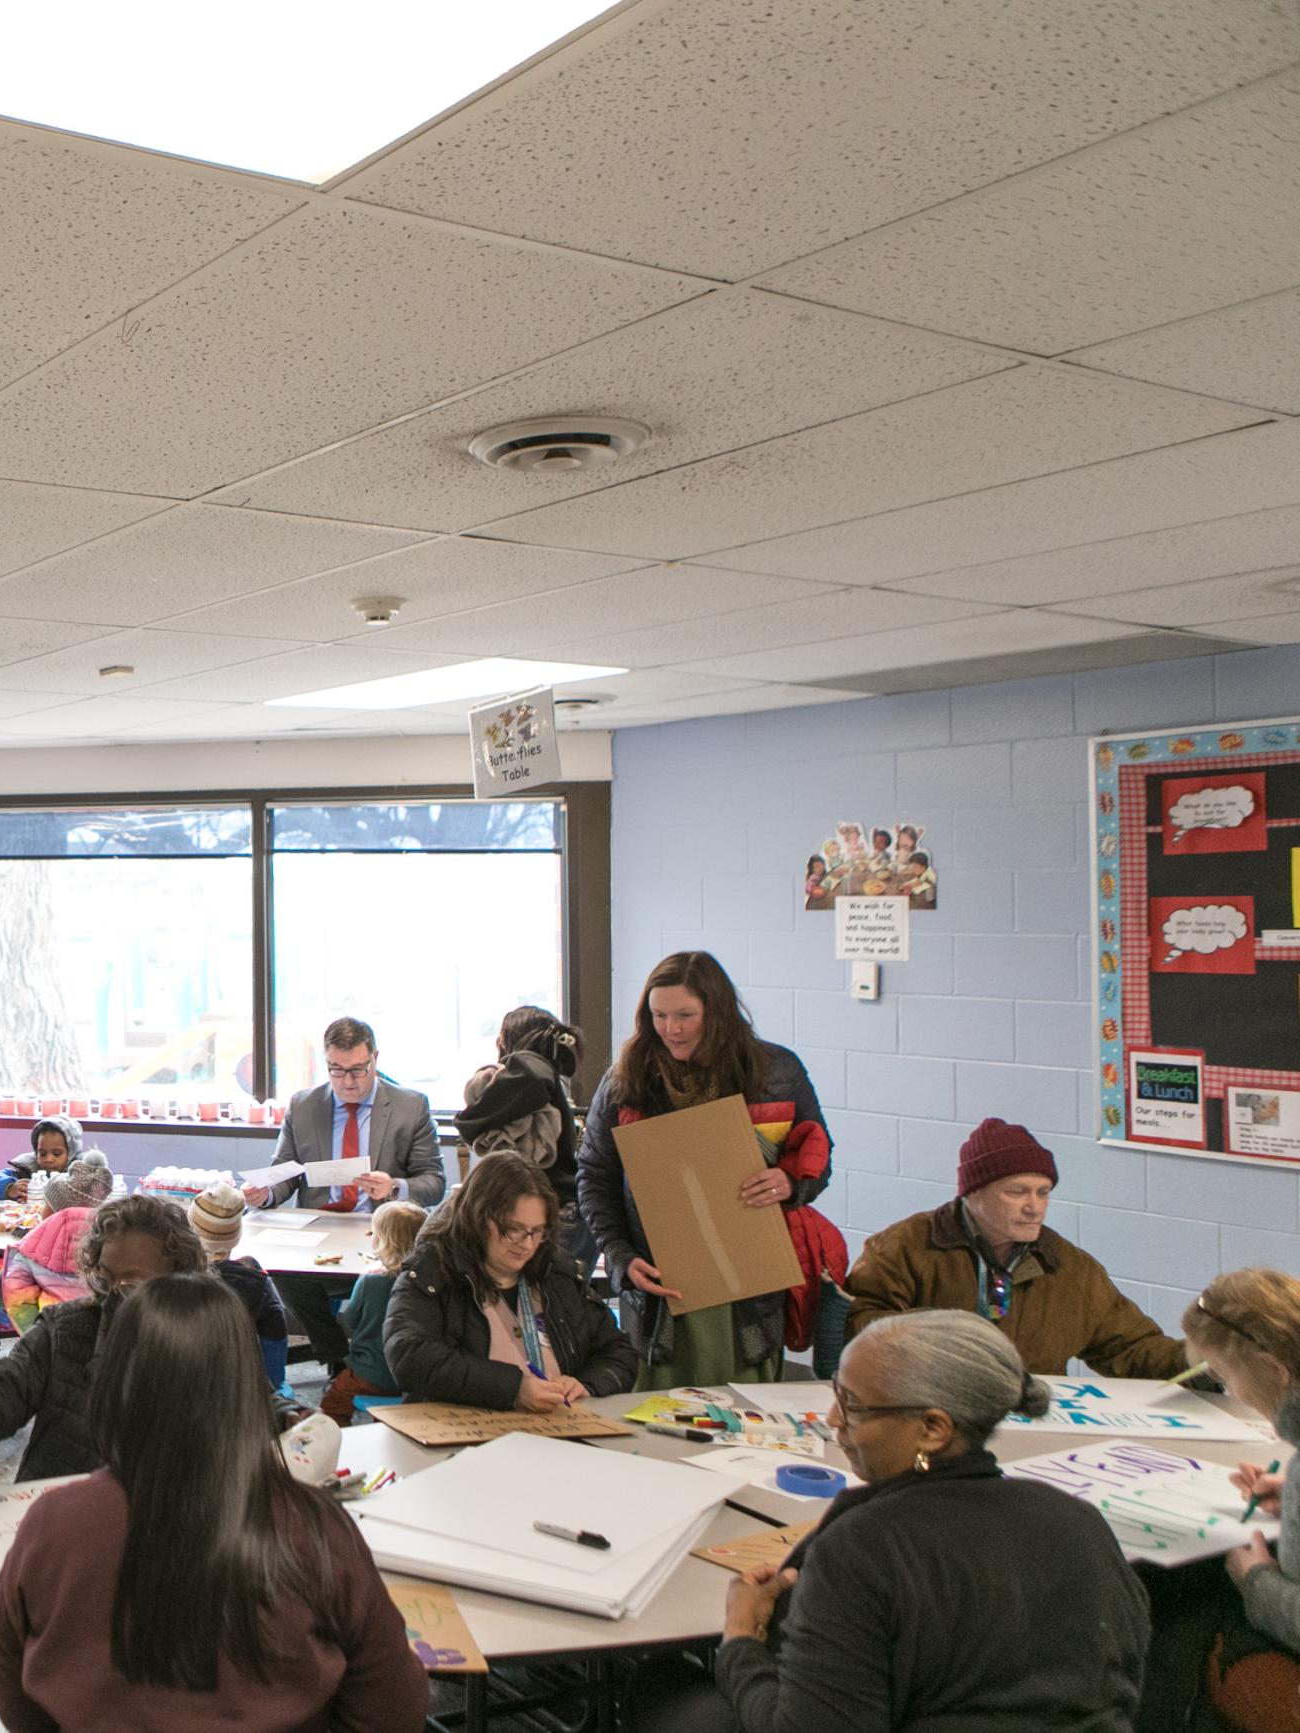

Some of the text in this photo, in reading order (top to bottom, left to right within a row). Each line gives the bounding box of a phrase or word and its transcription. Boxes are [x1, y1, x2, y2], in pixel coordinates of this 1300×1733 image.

[501, 766, 531, 782] Table
[856, 936, 886, 944] everyone
[1137, 1065, 1197, 1084] Breakfast
[1141, 1081, 1195, 1100] & Lunch
[1135, 1106, 1196, 1119] Our steps for
